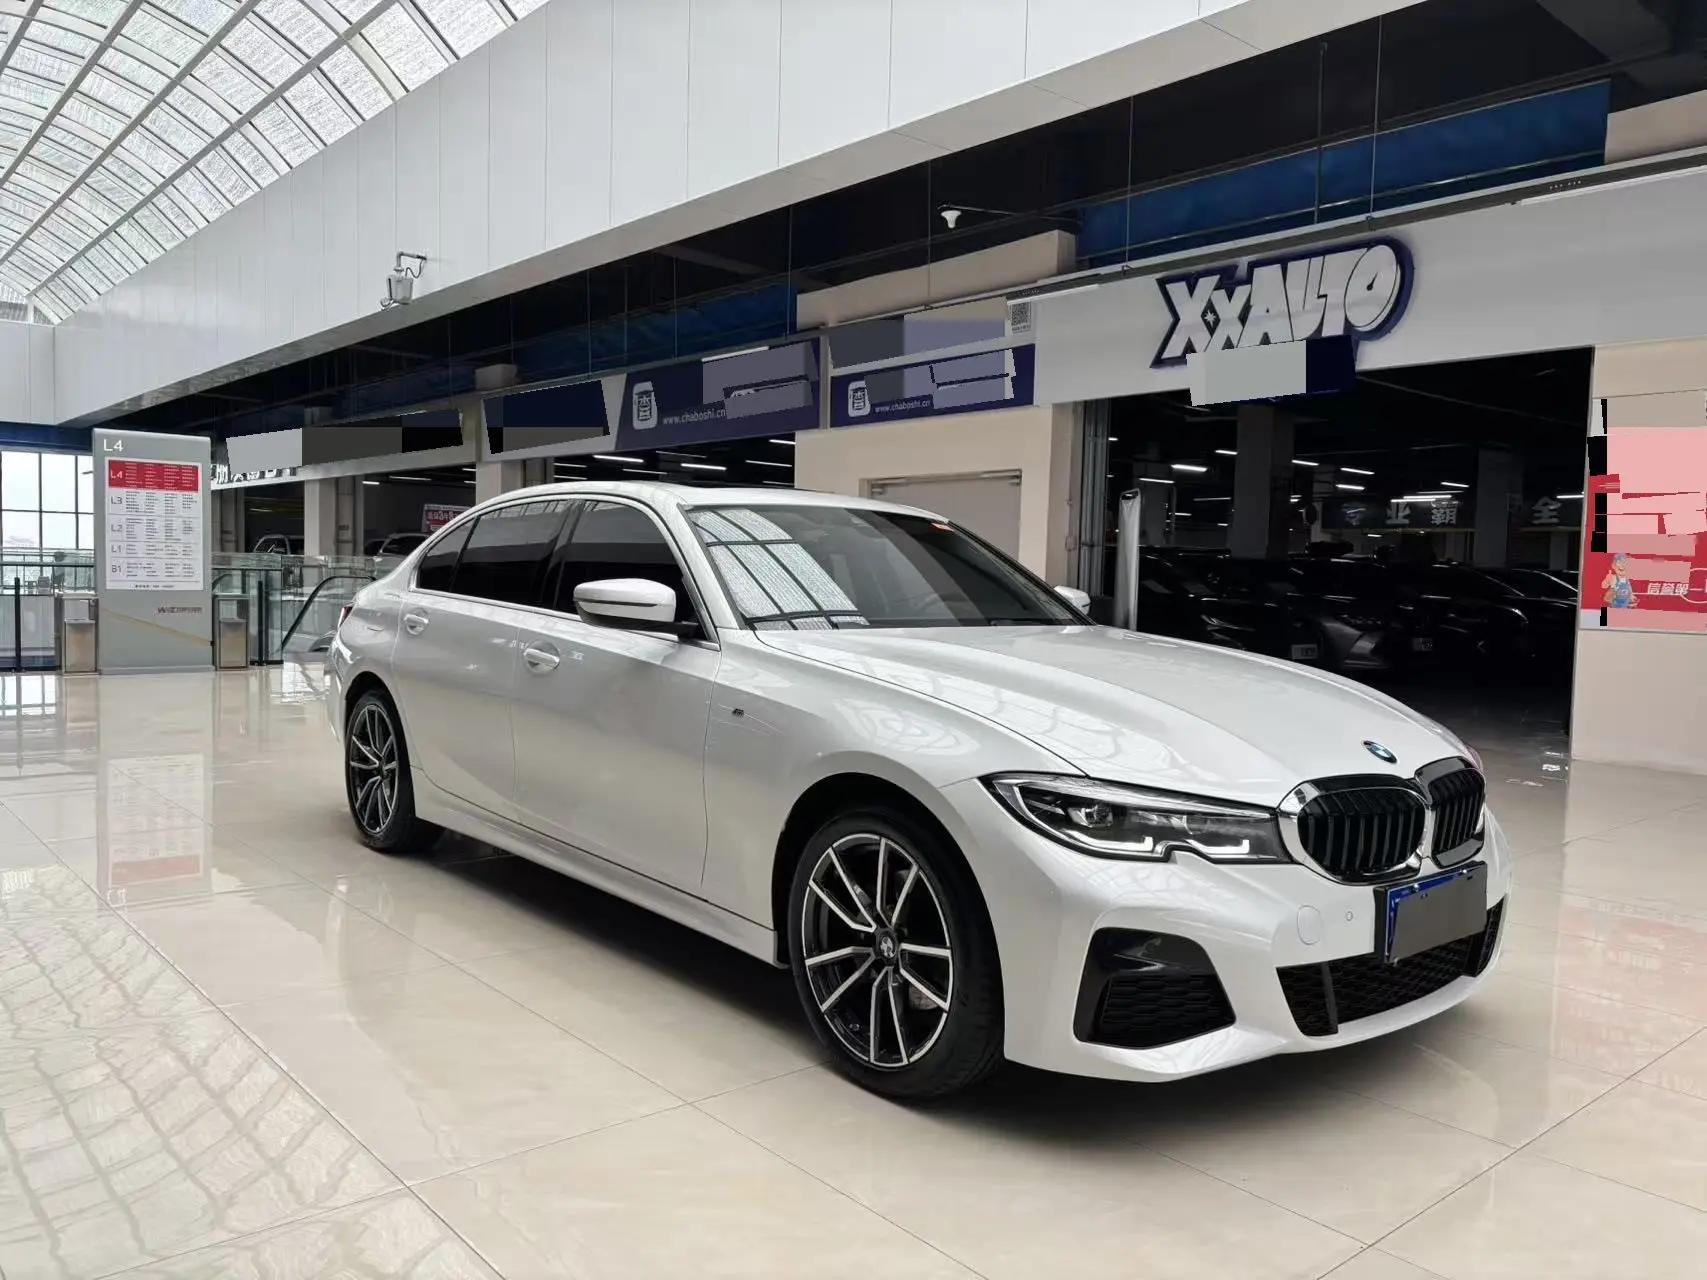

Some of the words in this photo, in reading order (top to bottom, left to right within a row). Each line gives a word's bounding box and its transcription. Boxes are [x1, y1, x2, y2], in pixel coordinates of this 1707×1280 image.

[662, 408, 726, 425] www.chaboshi.cn
[103, 438, 124, 452] L4
[110, 470, 123, 479] L4
[110, 496, 123, 505] L3
[110, 524, 123, 533] L2
[111, 544, 122, 553] L1
[111, 564, 122, 573] B1
